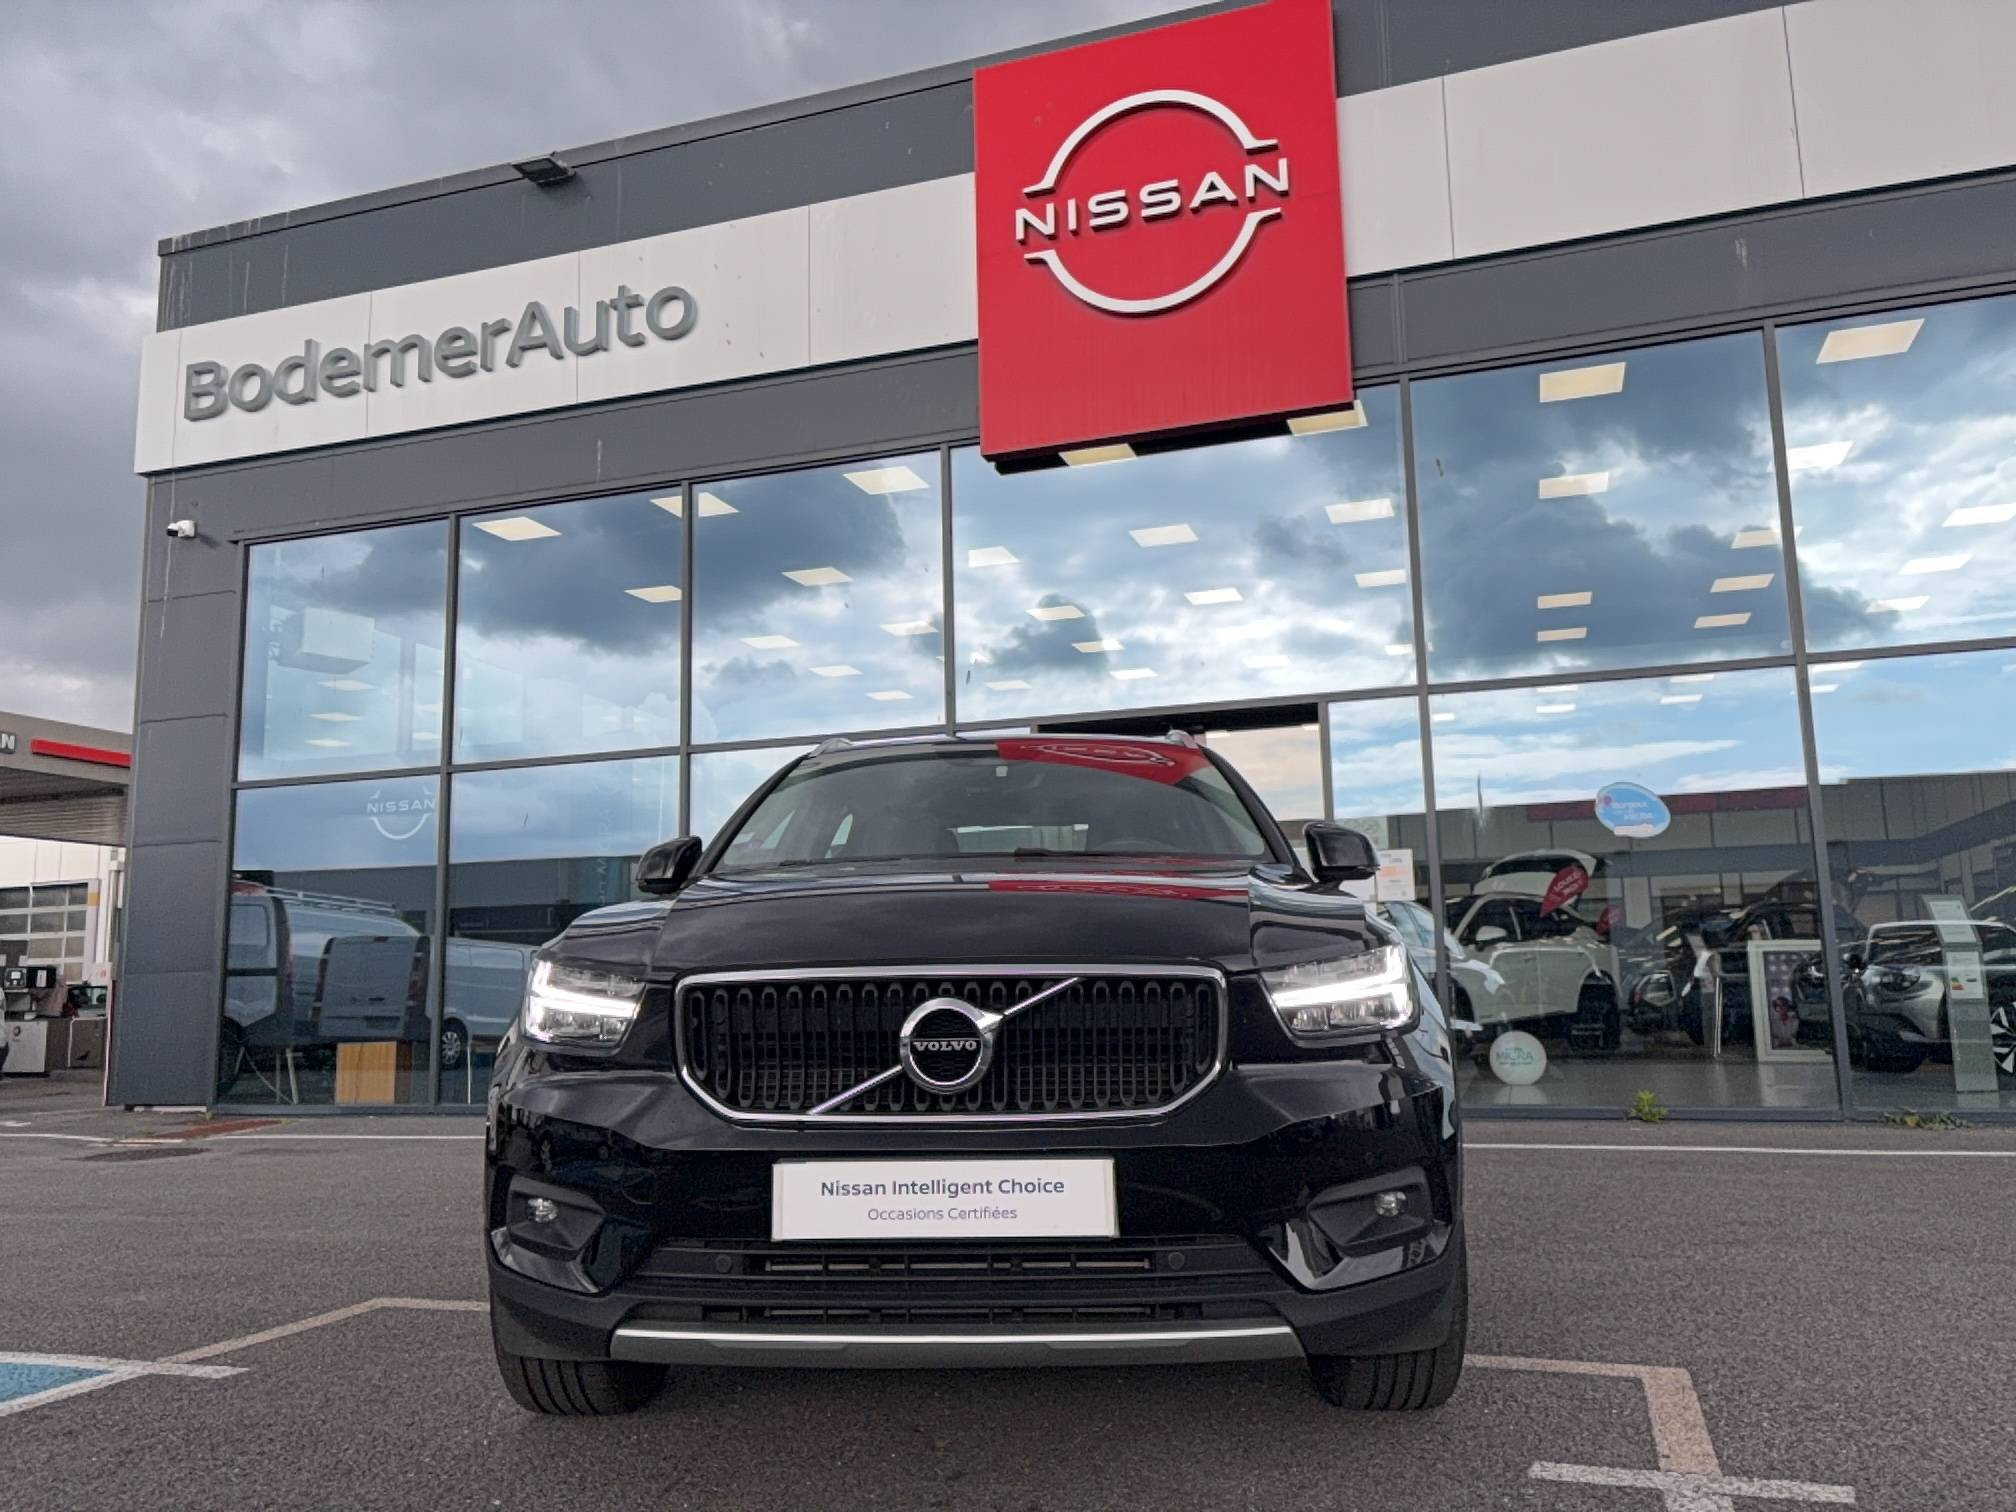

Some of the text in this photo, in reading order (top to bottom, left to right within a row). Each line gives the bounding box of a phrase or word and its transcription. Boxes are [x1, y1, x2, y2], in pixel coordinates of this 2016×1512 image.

[1015, 157, 1289, 244] NISSAN
[183, 284, 698, 421] BodemerAuto
[367, 799, 436, 813] NISSAN
[913, 1040, 977, 1051] VOLVO
[820, 1178, 1065, 1199] Nissan Intelligent Choice
[867, 1205, 1018, 1221] Occasions Certifiées
